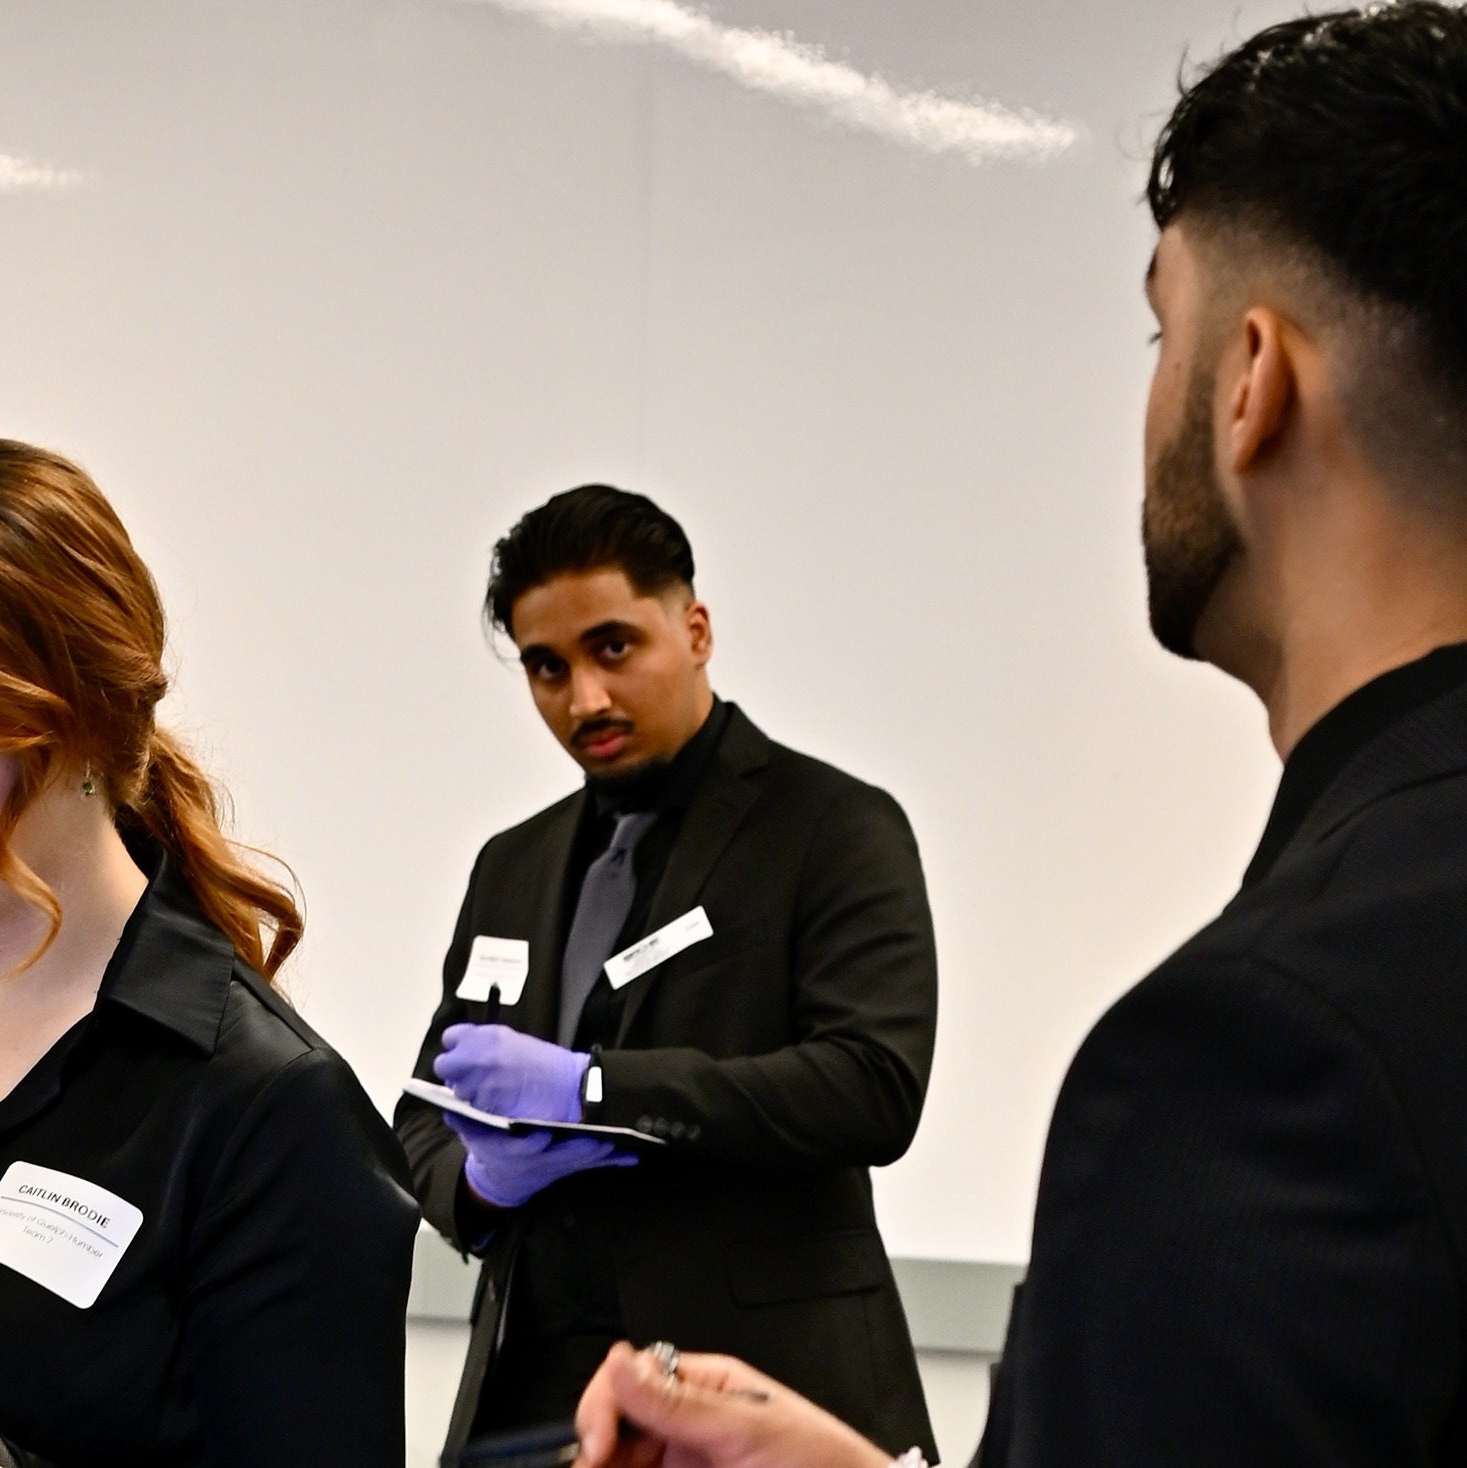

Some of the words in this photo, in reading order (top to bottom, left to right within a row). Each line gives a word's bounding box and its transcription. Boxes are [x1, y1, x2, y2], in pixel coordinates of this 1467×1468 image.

[18, 1184, 62, 1203] CAITLIN
[61, 1196, 111, 1229] BRODIE
[22, 1227, 47, 1241] Team
